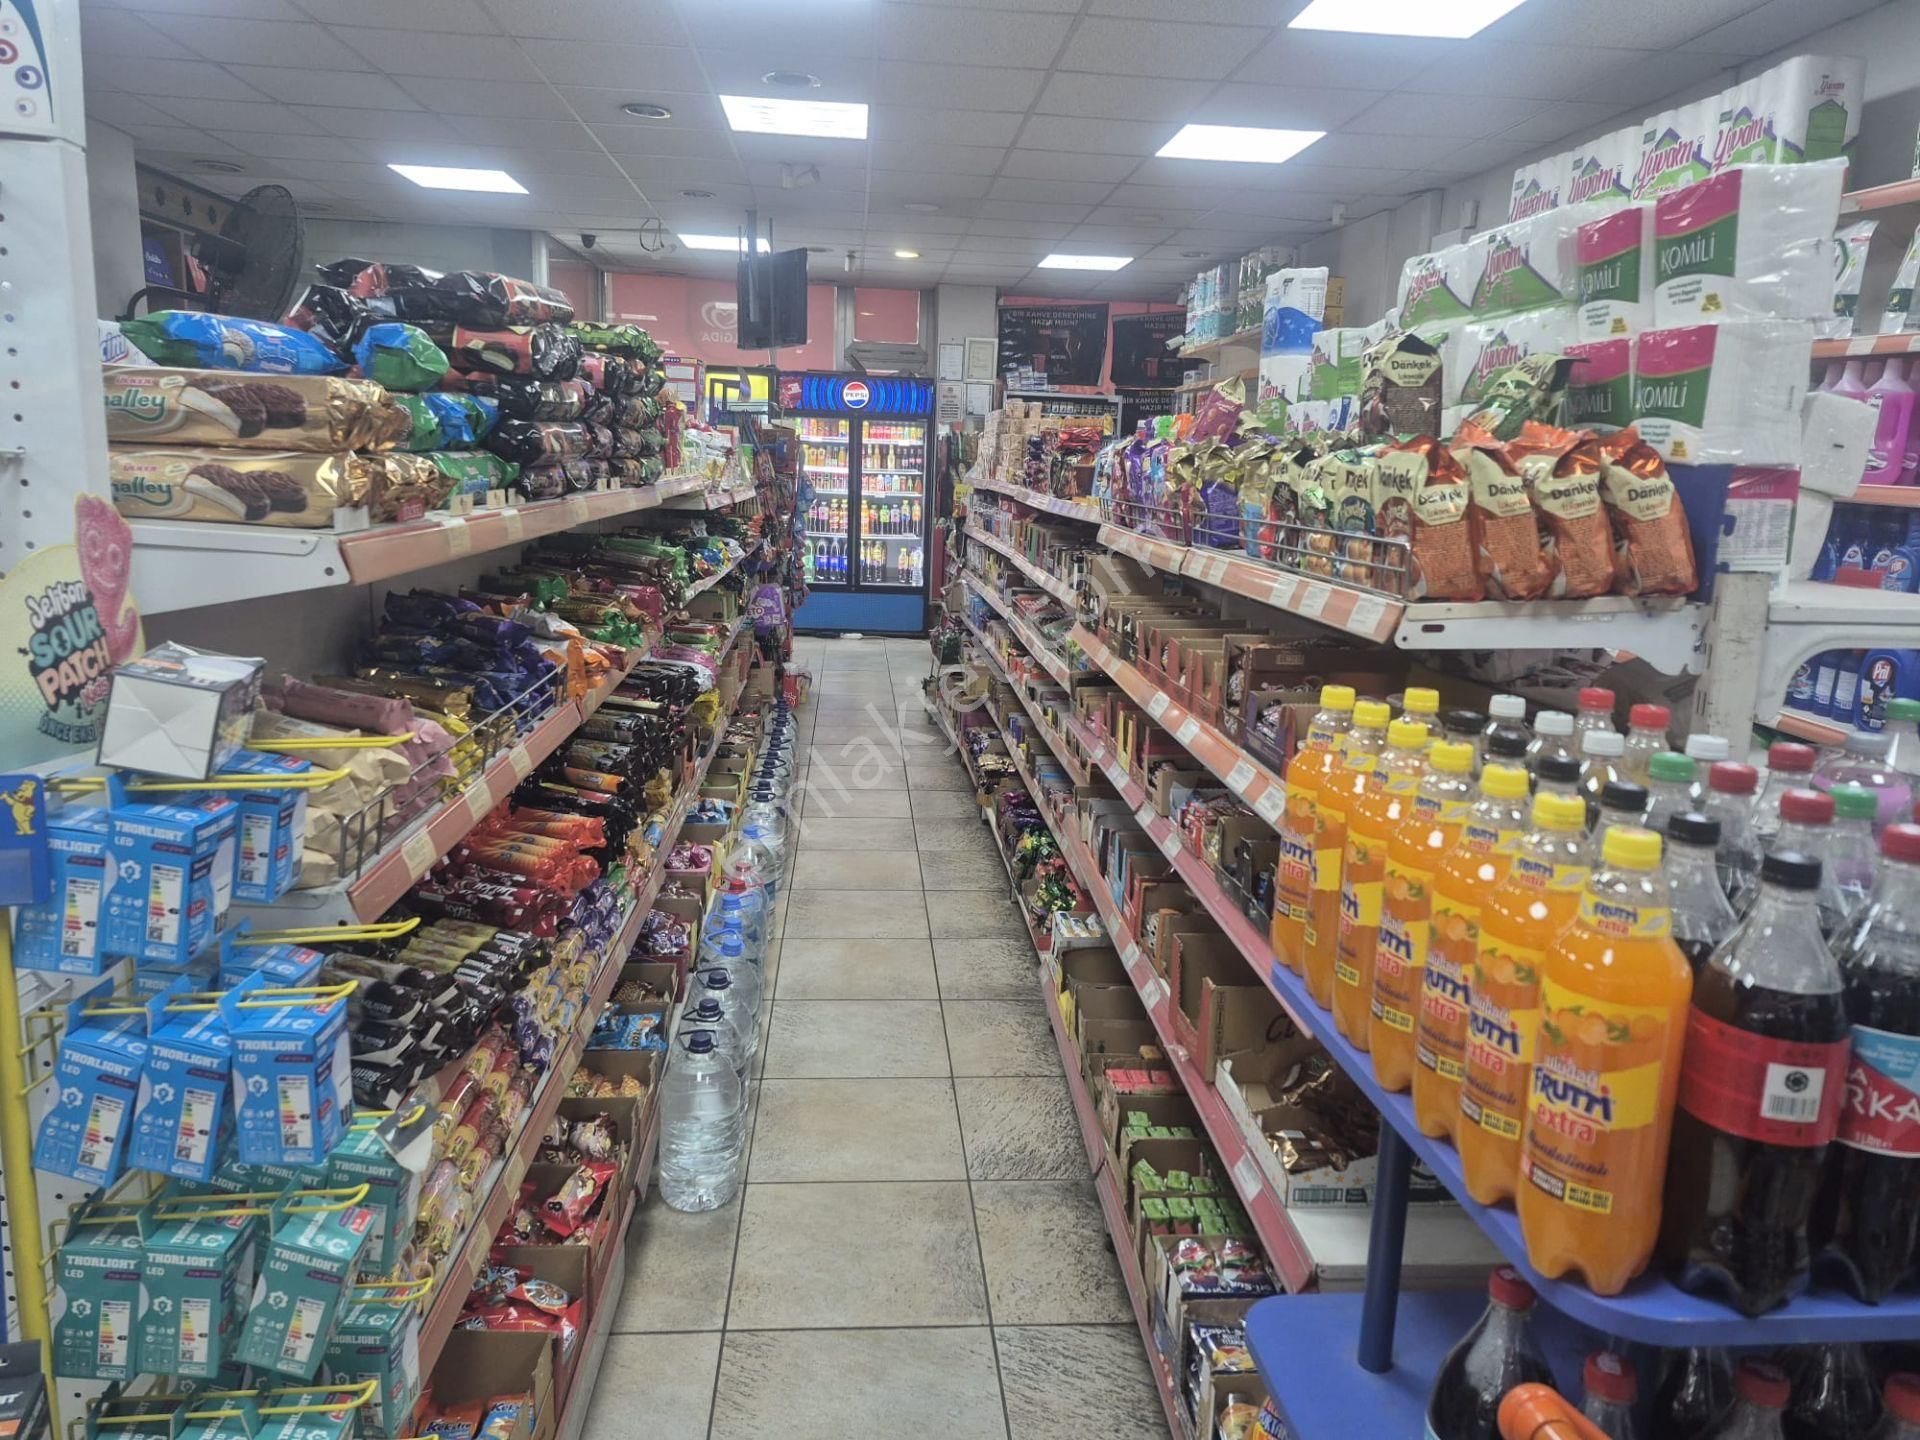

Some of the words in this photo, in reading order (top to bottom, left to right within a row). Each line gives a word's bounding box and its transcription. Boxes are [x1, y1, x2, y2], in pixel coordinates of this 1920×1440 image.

[29, 606, 103, 669] SOUR
[36, 635, 113, 706] PATCH
[236, 1038, 307, 1052] THORLIGHT
[63, 1049, 135, 1077] THORLIGHT
[150, 1044, 221, 1070] THORLIGHT
[238, 1053, 258, 1065] LED
[61, 1062, 81, 1077] LED
[150, 1058, 171, 1072] LED
[335, 1160, 395, 1178] THORLIGHT
[66, 1255, 138, 1270] THORLIGHT
[147, 1252, 218, 1268] THORLIGHT
[269, 1259, 289, 1273] LED
[273, 1246, 343, 1273] THORLIGHT
[64, 1269, 85, 1279] LED
[146, 1266, 166, 1277] LED
